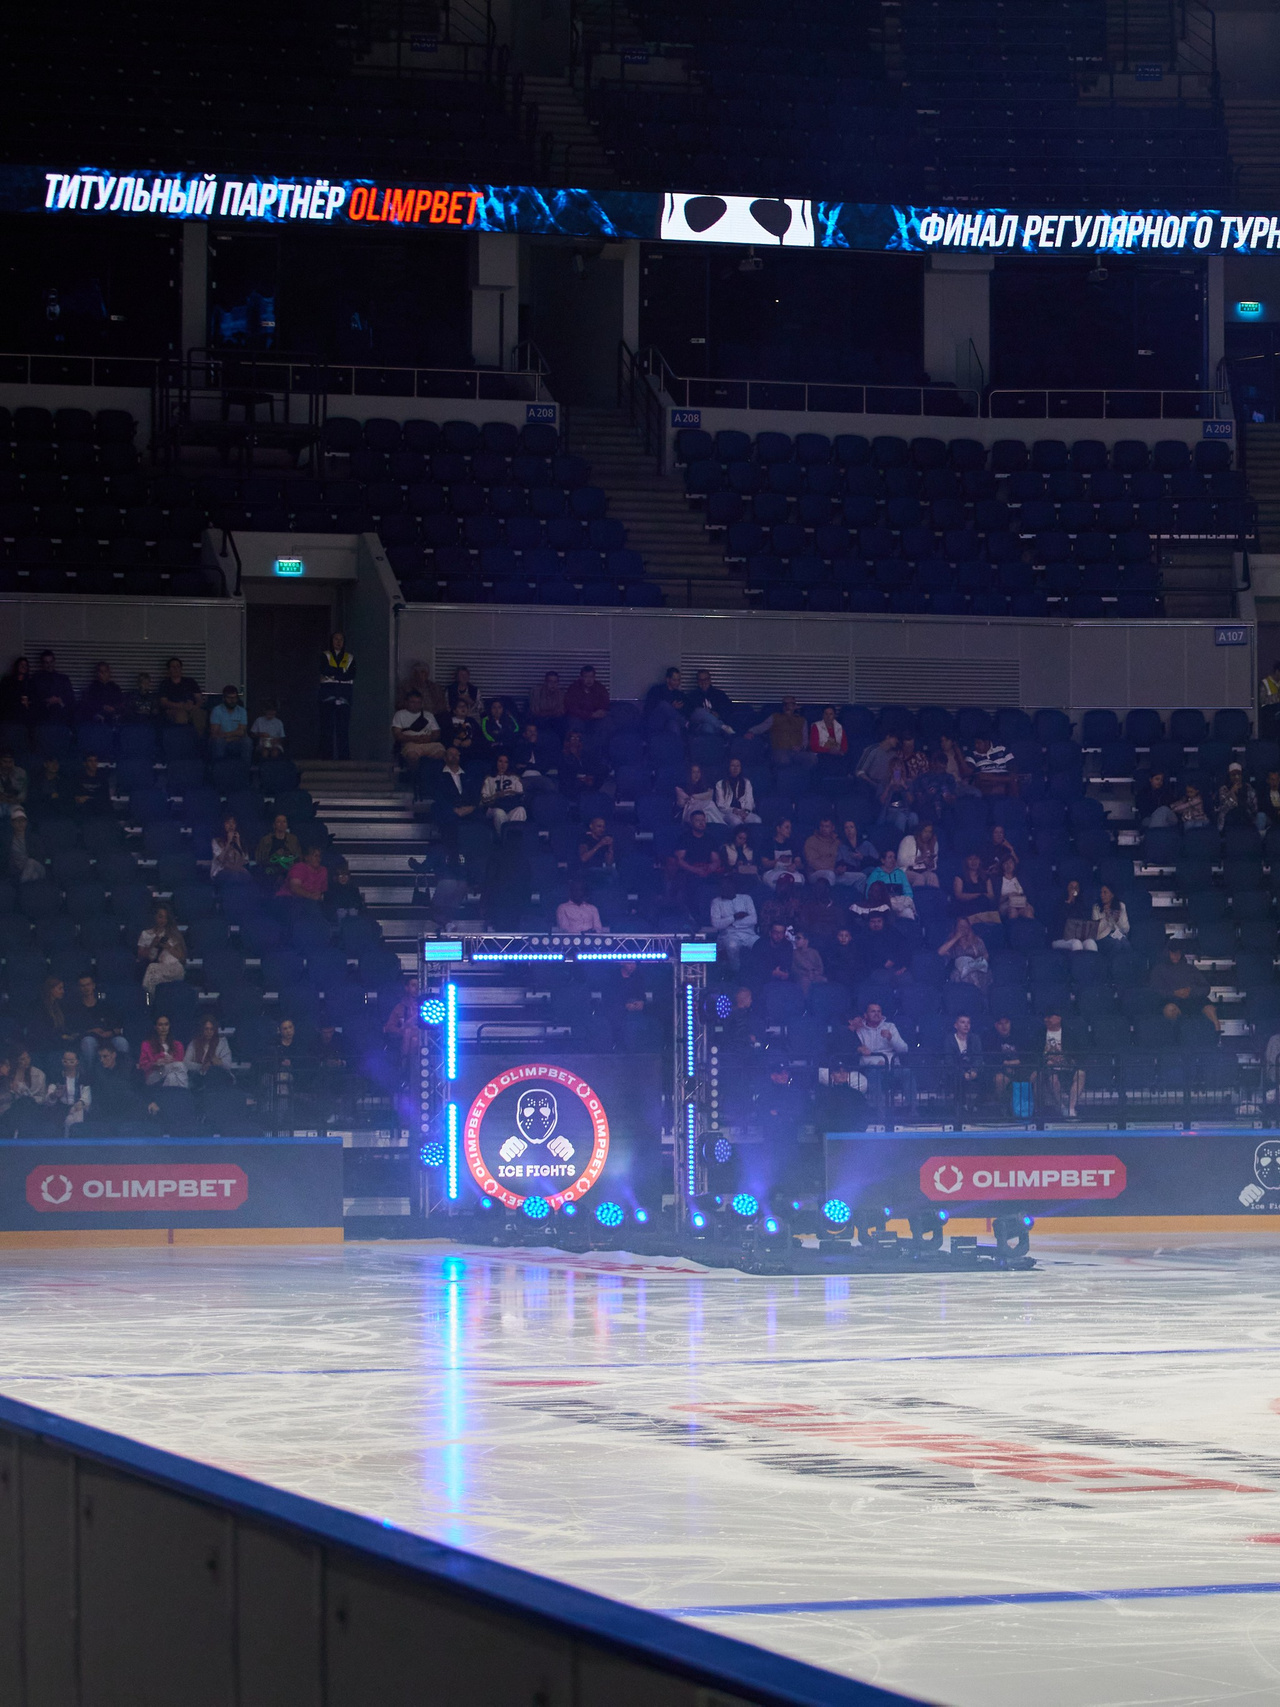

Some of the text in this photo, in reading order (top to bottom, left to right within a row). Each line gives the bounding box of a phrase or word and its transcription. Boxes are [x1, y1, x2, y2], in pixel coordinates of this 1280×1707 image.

[45, 173, 484, 225] ТИТУЛЬНЫЙ ПАРТНЁР OLIMPBET
[919, 212, 1019, 248] ФИНАЛ
[1021, 214, 1213, 249] РЕГУЛЯРНОГО
[500, 1067, 576, 1085] OLIMPBET
[468, 1098, 486, 1178] OLIMPBET
[589, 1100, 606, 1178] OLIMPBET
[498, 1164, 576, 1177] ICE FIGHTS
[972, 1169, 1115, 1188] OLIMPBET
[82, 1179, 237, 1198] OLIMPBET
